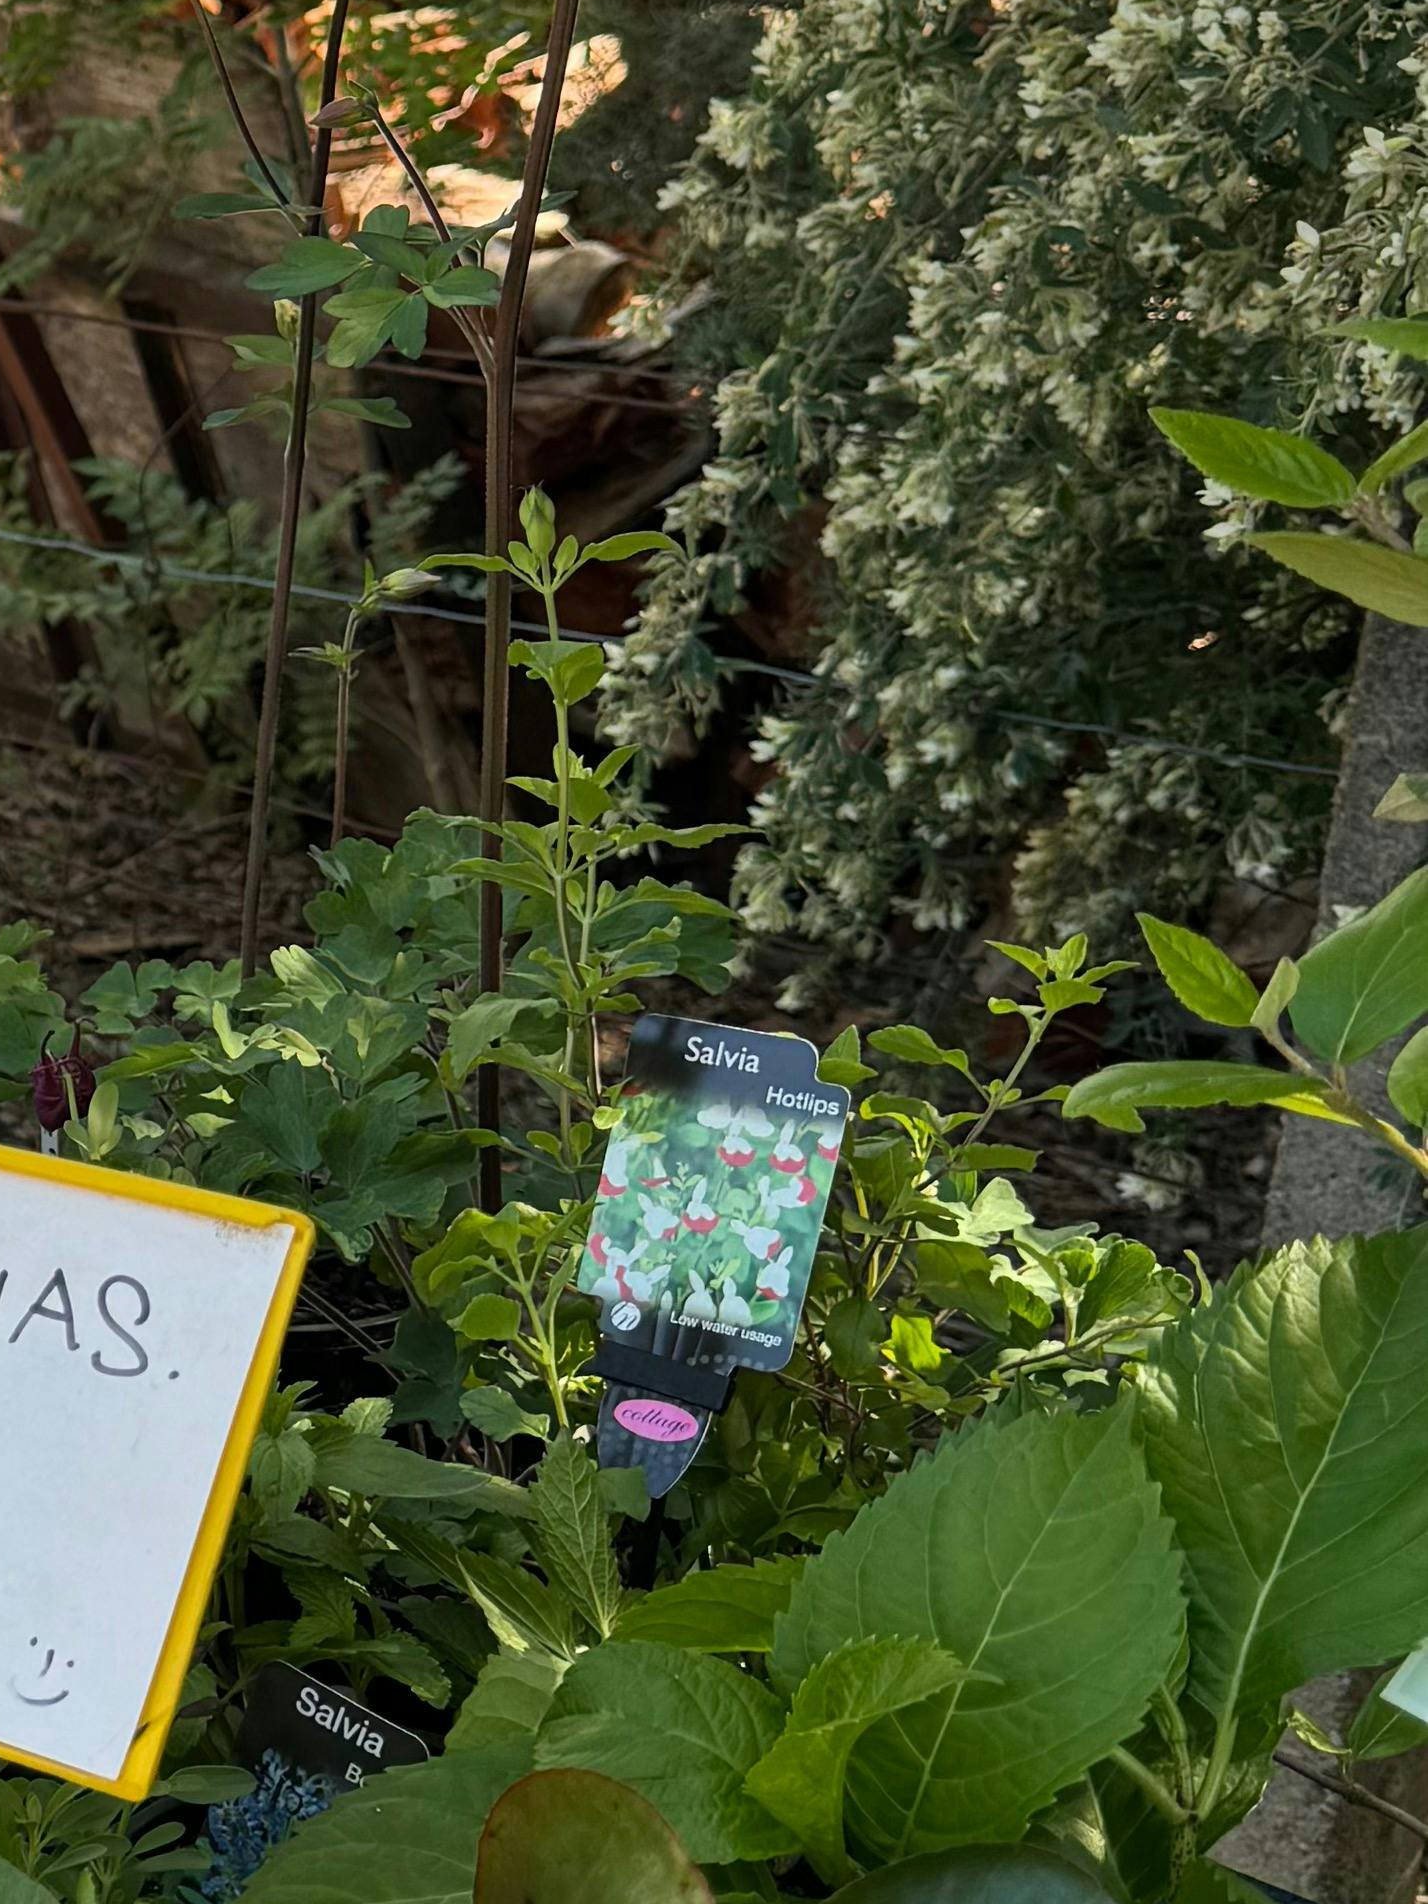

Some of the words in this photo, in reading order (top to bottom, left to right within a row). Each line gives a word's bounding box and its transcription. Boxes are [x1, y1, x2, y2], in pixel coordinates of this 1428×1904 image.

[682, 1034, 761, 1075] Salvia
[764, 1084, 841, 1119] Hotlips
[669, 1310, 701, 1330] Low
[701, 1319, 740, 1340] water
[740, 1325, 783, 1349] usage
[618, 1401, 694, 1436] cottage
[294, 1685, 387, 1760] Salvia
